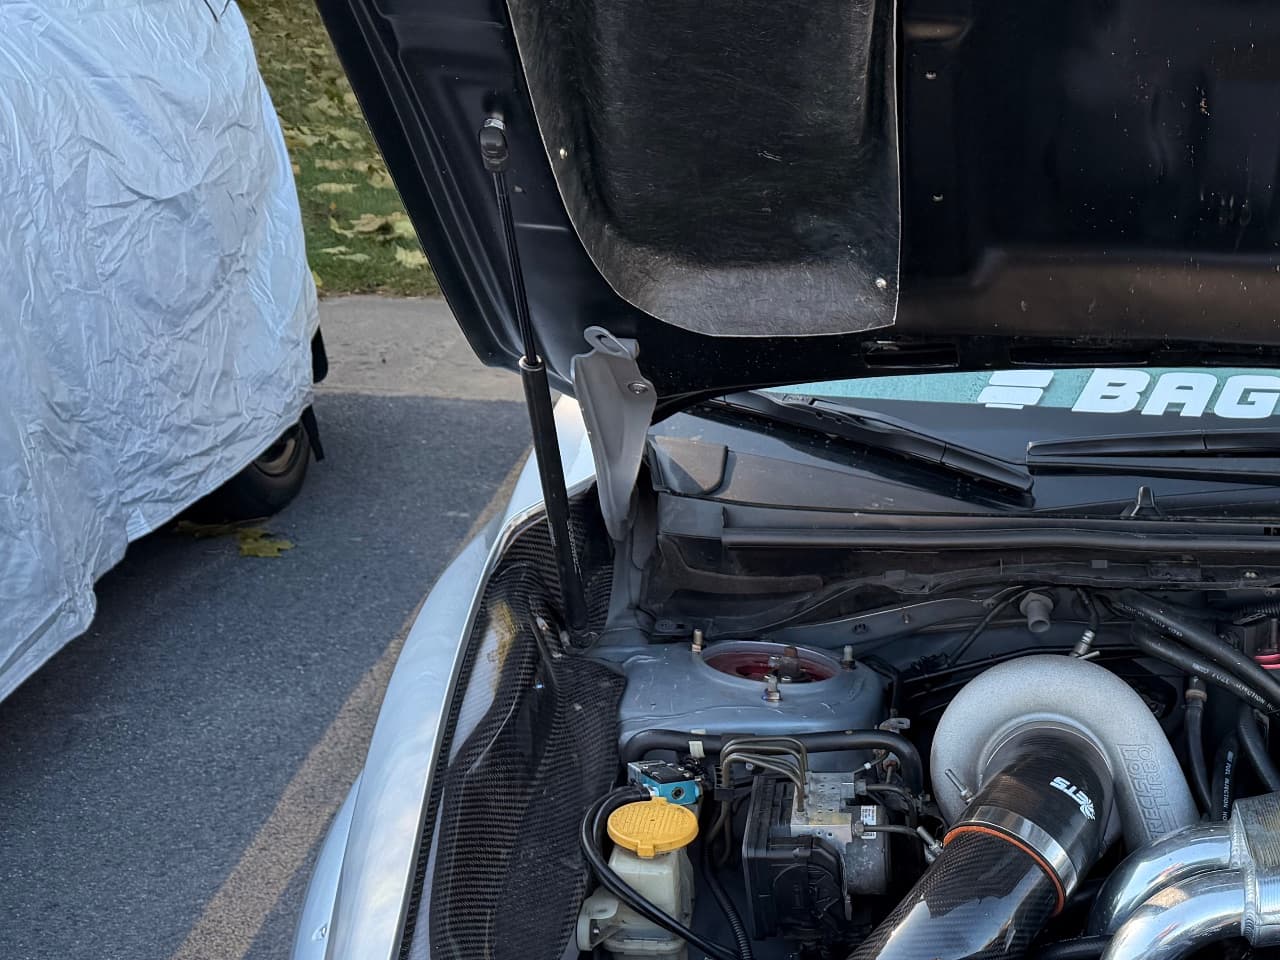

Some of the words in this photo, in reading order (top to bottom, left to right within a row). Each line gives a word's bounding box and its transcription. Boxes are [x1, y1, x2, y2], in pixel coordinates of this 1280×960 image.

[1049, 776, 1088, 805] ETS
[1117, 744, 1166, 839] RECISION
[1137, 745, 1170, 807] TURBO
